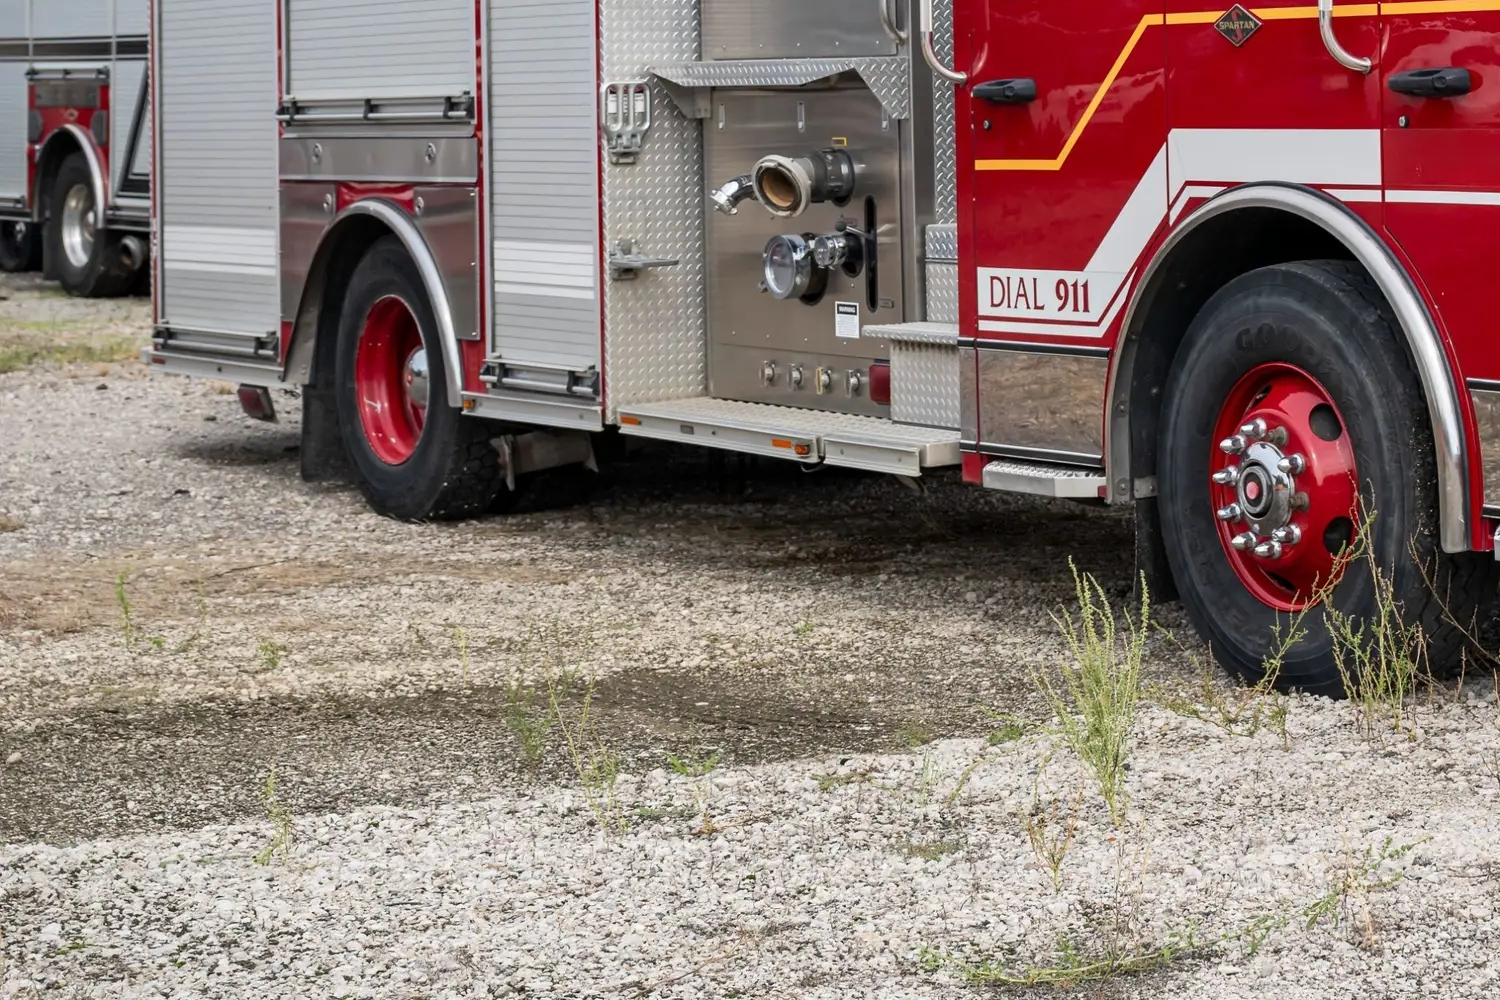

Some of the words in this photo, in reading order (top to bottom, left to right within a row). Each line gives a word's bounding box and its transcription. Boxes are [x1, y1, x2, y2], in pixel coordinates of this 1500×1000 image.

[1219, 21, 1255, 30] SPARTAN
[989, 275, 1045, 310] DIAL
[1055, 278, 1090, 313] 911
